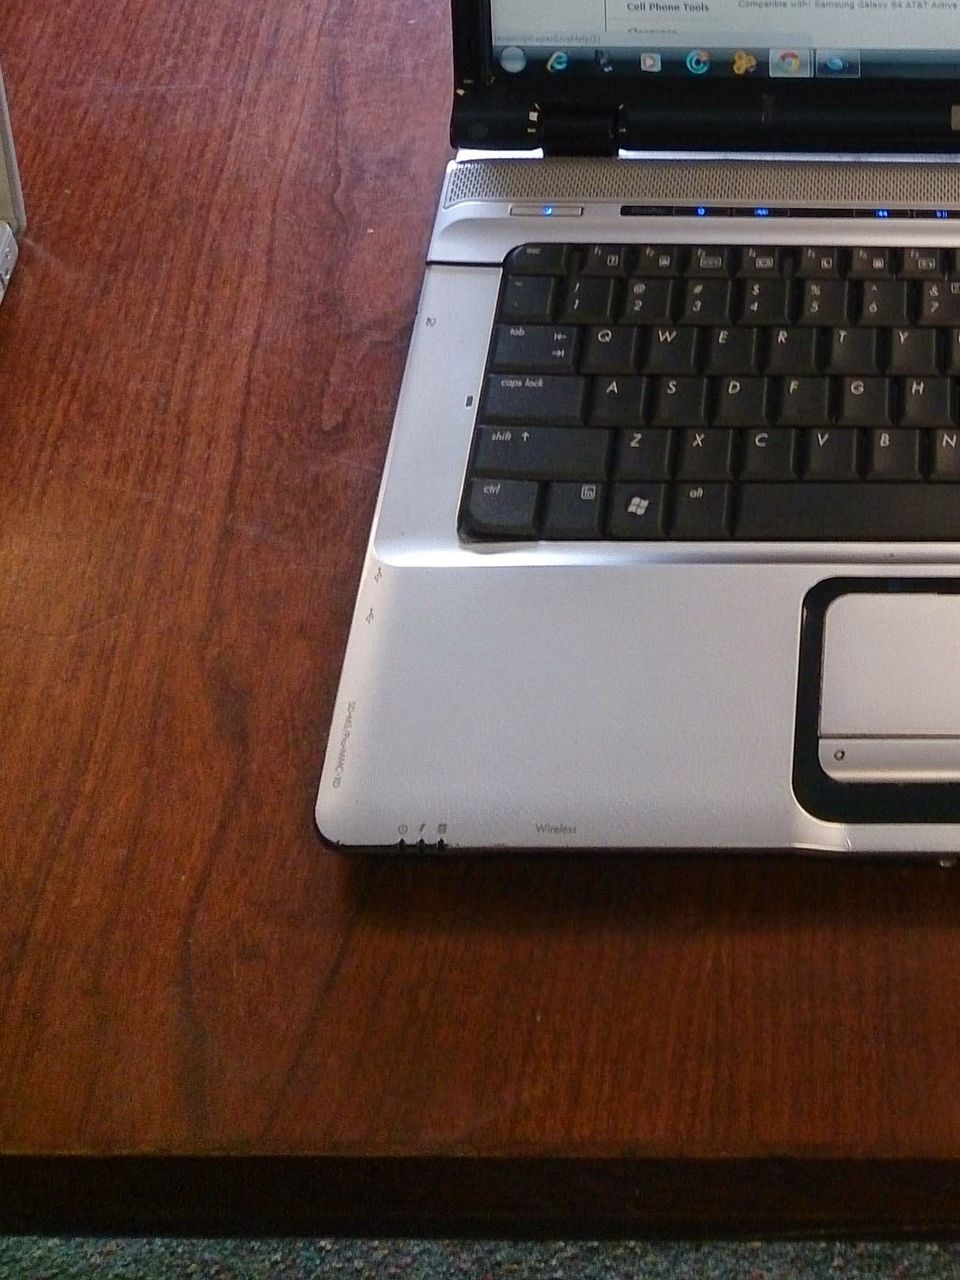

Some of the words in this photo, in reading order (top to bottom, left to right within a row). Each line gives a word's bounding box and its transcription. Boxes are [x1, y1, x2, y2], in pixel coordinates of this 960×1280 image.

[627, 2, 646, 11] Cell
[649, 2, 680, 11] Phone
[684, 3, 709, 12] Tools
[633, 301, 642, 311] 2
[693, 301, 701, 311] 3
[750, 301, 758, 312] 4
[510, 327, 525, 337] tab
[597, 330, 613, 344] Q
[658, 330, 676, 343] W
[718, 330, 728, 343] E
[777, 330, 788, 344] R
[838, 332, 847, 344] T
[899, 332, 908, 344] Y
[501, 379, 522, 389] caps
[525, 377, 544, 388] lock
[606, 381, 619, 394] A
[667, 381, 676, 394] S
[728, 381, 740, 394] D
[789, 381, 798, 394] F
[850, 381, 864, 395] G
[911, 382, 924, 395] H
[491, 432, 511, 442] shift
[630, 433, 640, 447] Z
[693, 434, 705, 447] X
[755, 433, 768, 447] C
[817, 433, 829, 447] V
[880, 434, 889, 447] B
[942, 434, 957, 448] N
[483, 484, 500, 495] ctrl
[689, 486, 703, 499] alt
[536, 823, 577, 834] Wireless
